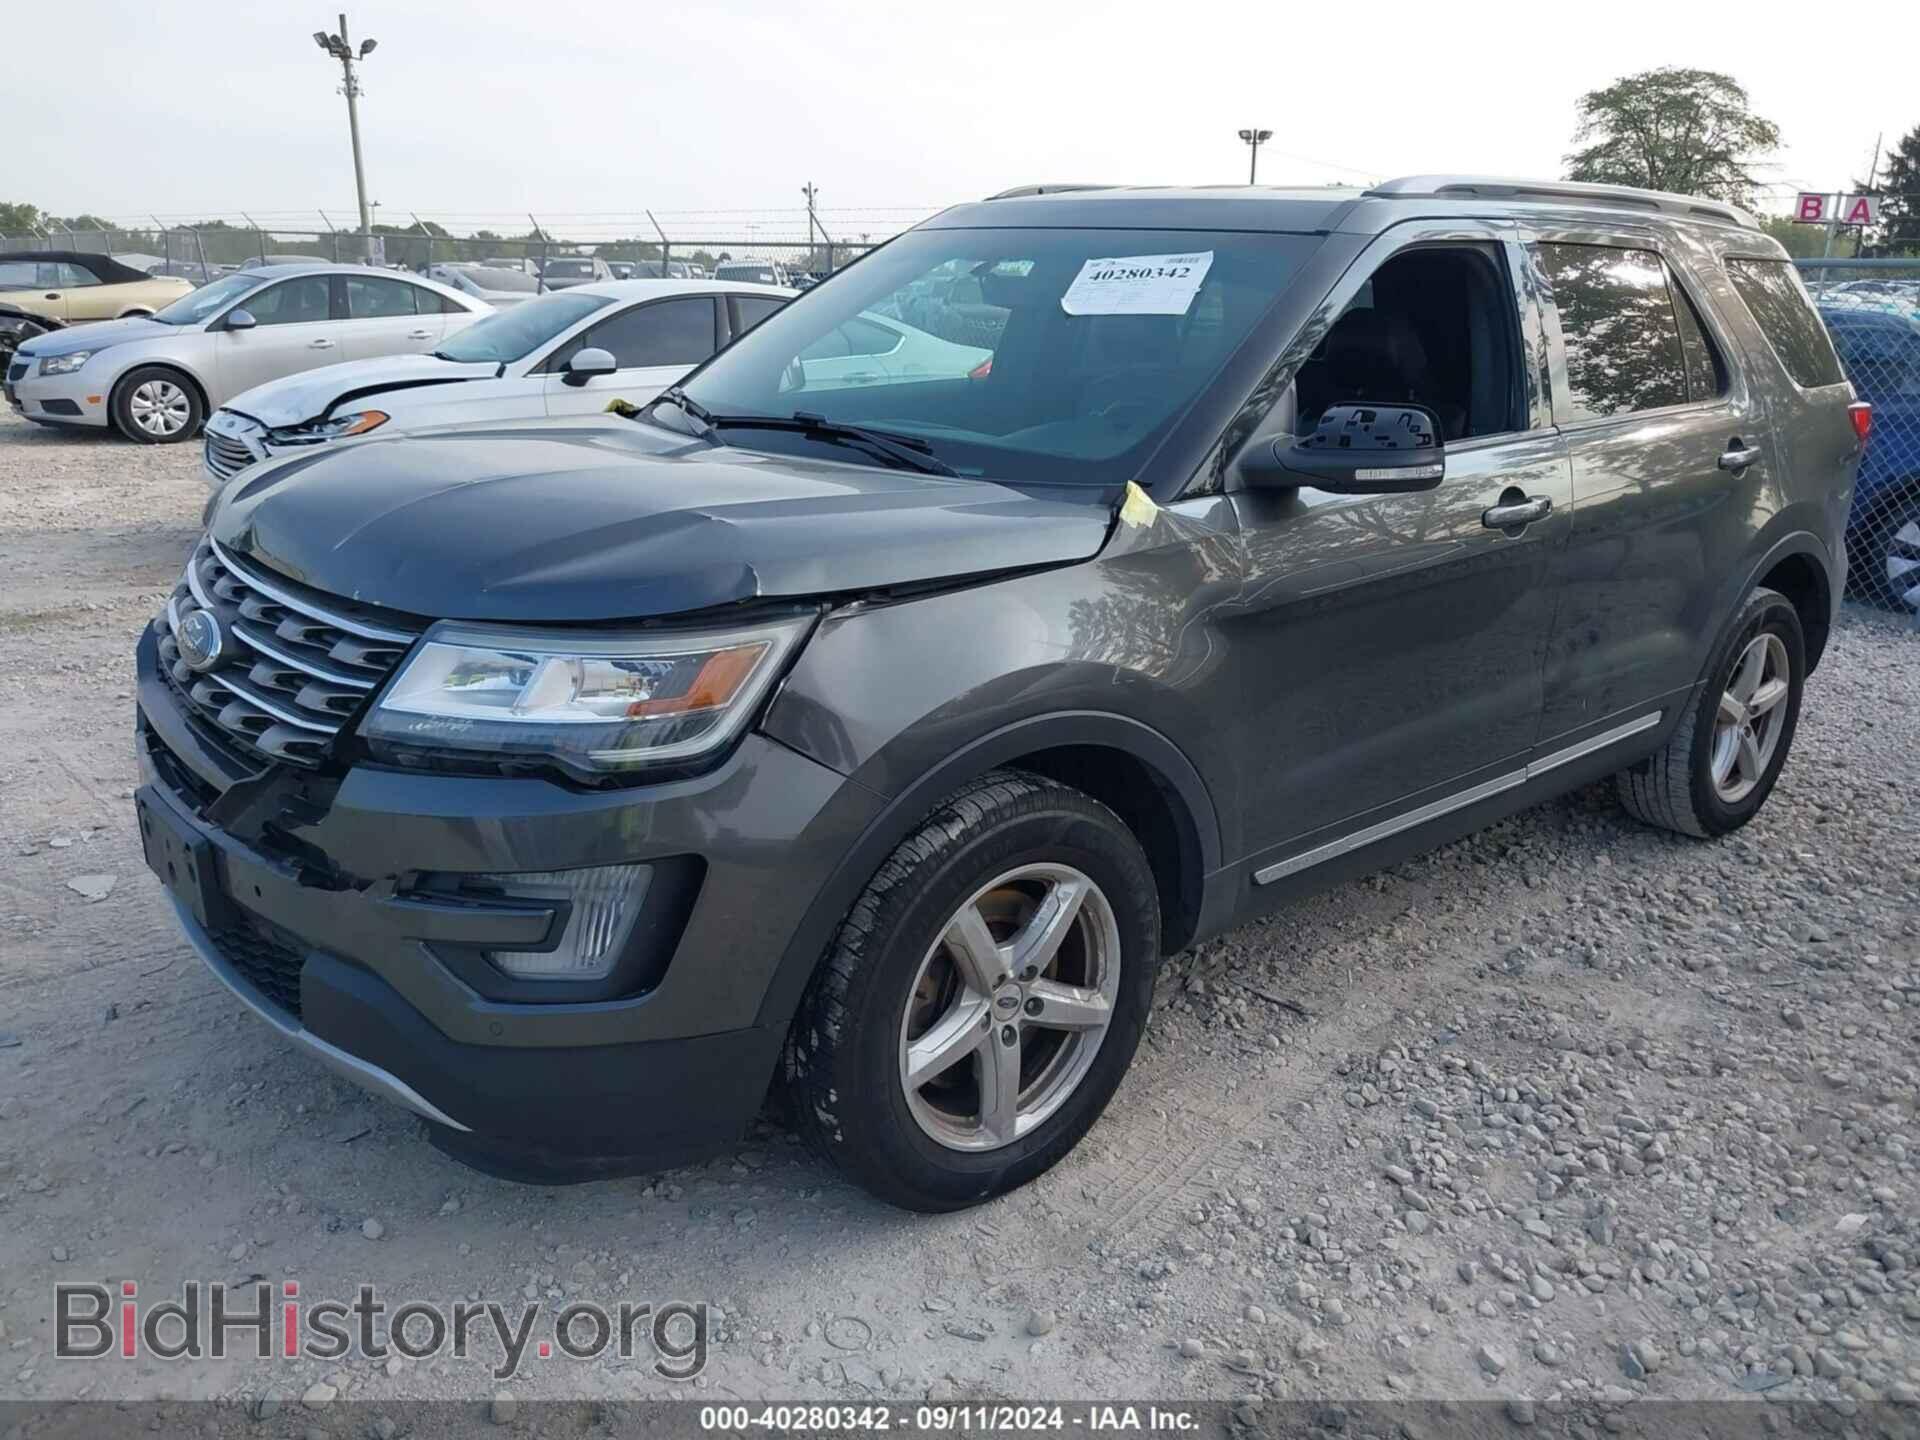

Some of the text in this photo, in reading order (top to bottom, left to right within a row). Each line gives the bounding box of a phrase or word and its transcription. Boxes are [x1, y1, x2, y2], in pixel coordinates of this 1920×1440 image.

[1801, 196, 1823, 219] B
[1848, 198, 1870, 224] A
[1089, 267, 1192, 281] 40280342
